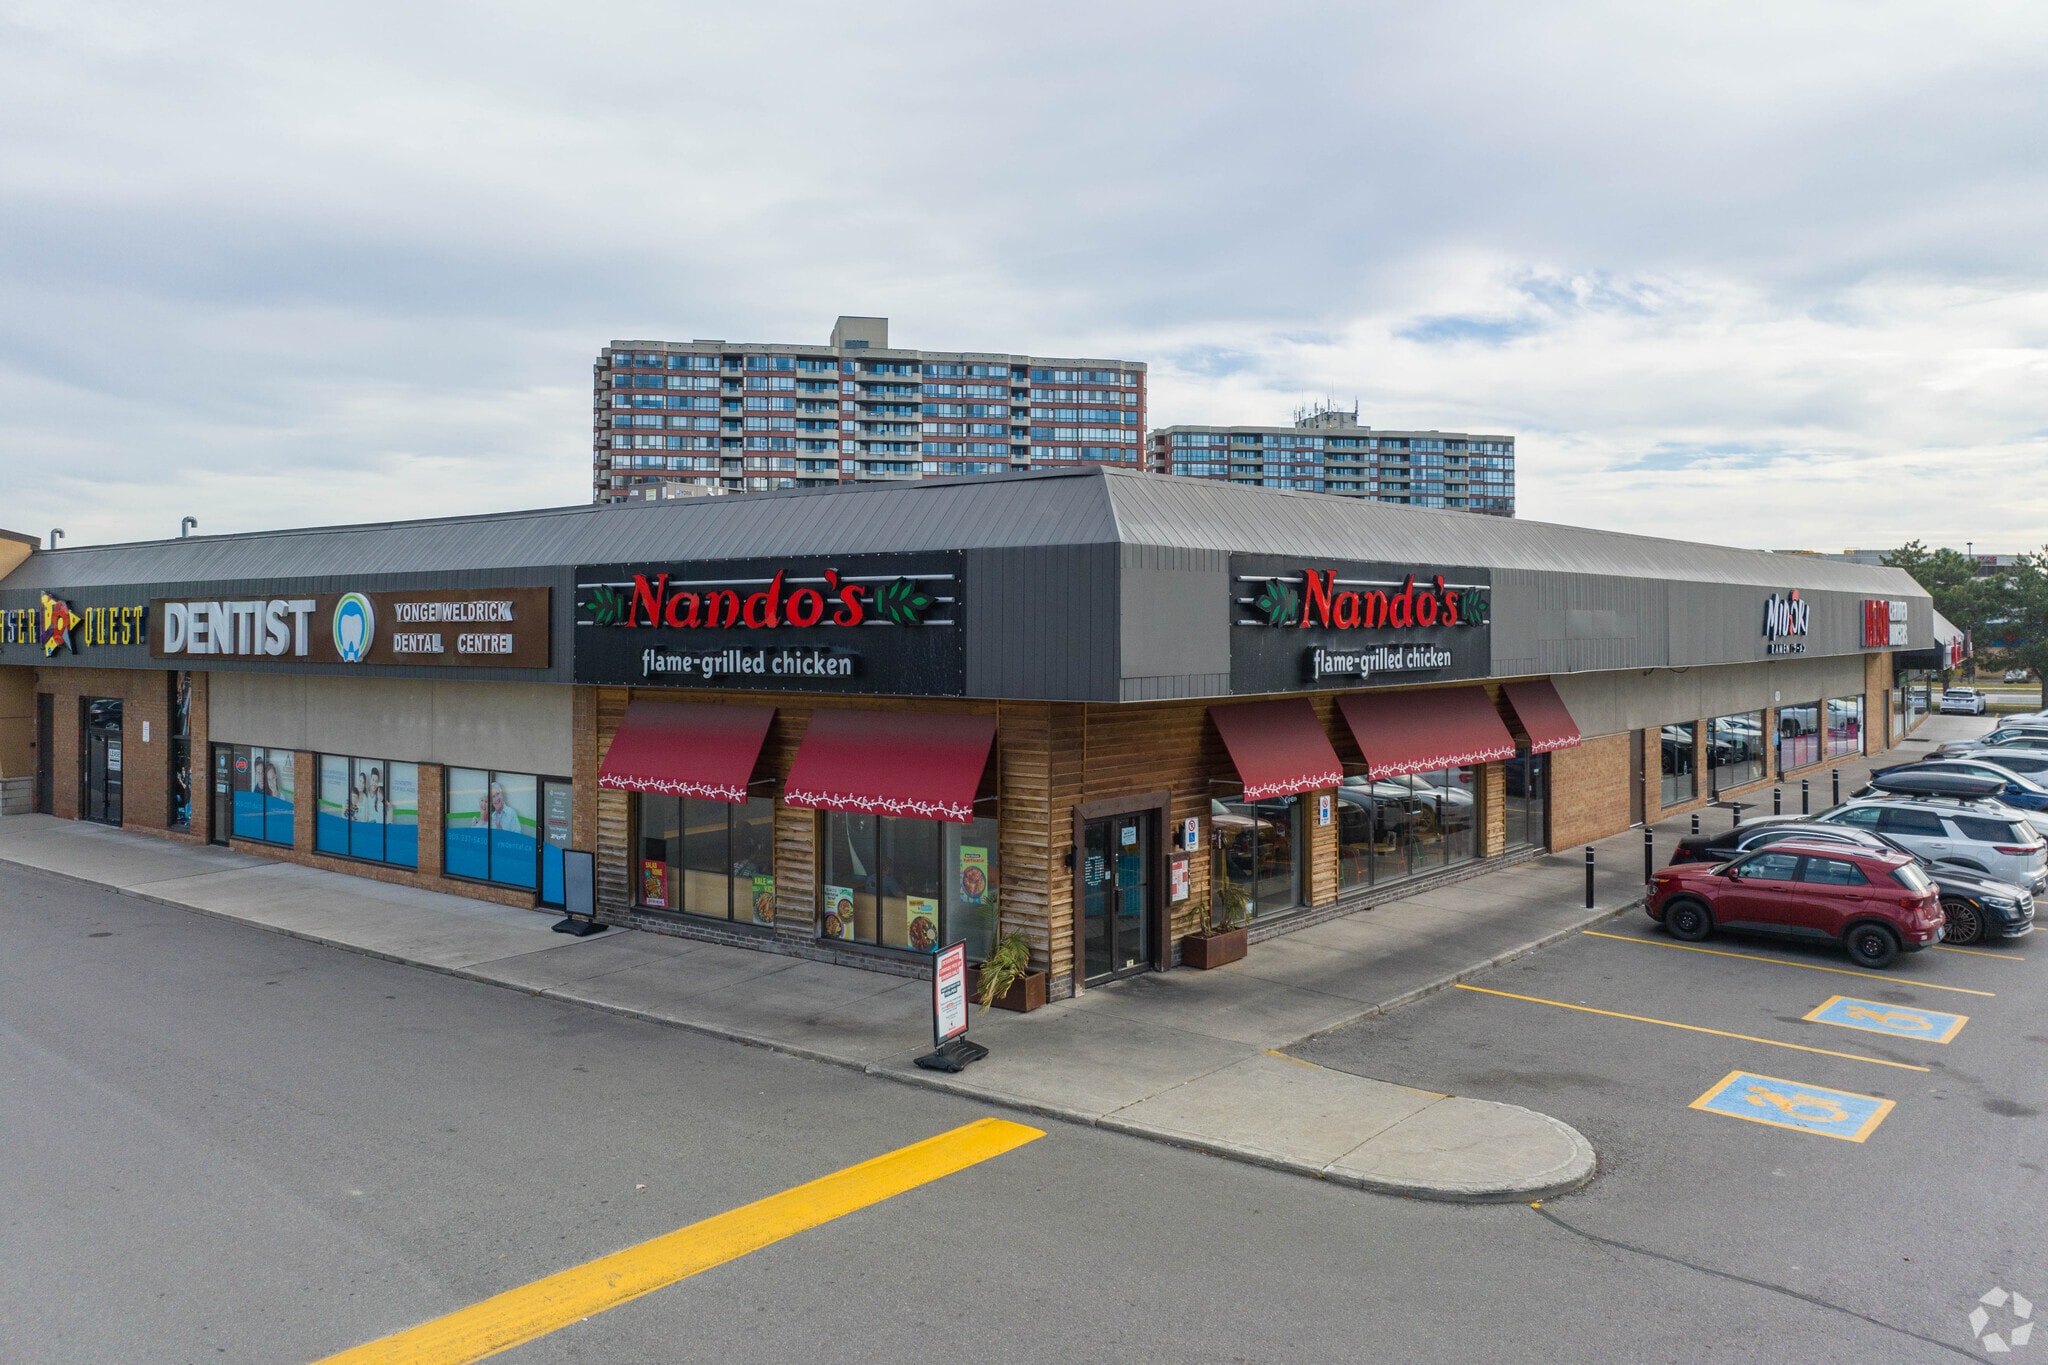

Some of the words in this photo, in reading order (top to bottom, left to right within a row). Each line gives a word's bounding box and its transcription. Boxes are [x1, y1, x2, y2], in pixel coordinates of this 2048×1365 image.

[394, 603, 442, 622] YONGE
[442, 600, 513, 622] WELDRICK
[625, 567, 866, 629] Nando's
[1300, 567, 1459, 629] Nando's
[85, 605, 145, 647] QUEST
[164, 599, 316, 656] DENTIST
[393, 633, 444, 653] DENTAL
[457, 633, 513, 654] CENTRE
[642, 648, 765, 679] flame-grilled
[771, 650, 851, 676] chicken
[1314, 647, 1403, 680] flame-grilled
[1406, 646, 1451, 669] chicken
